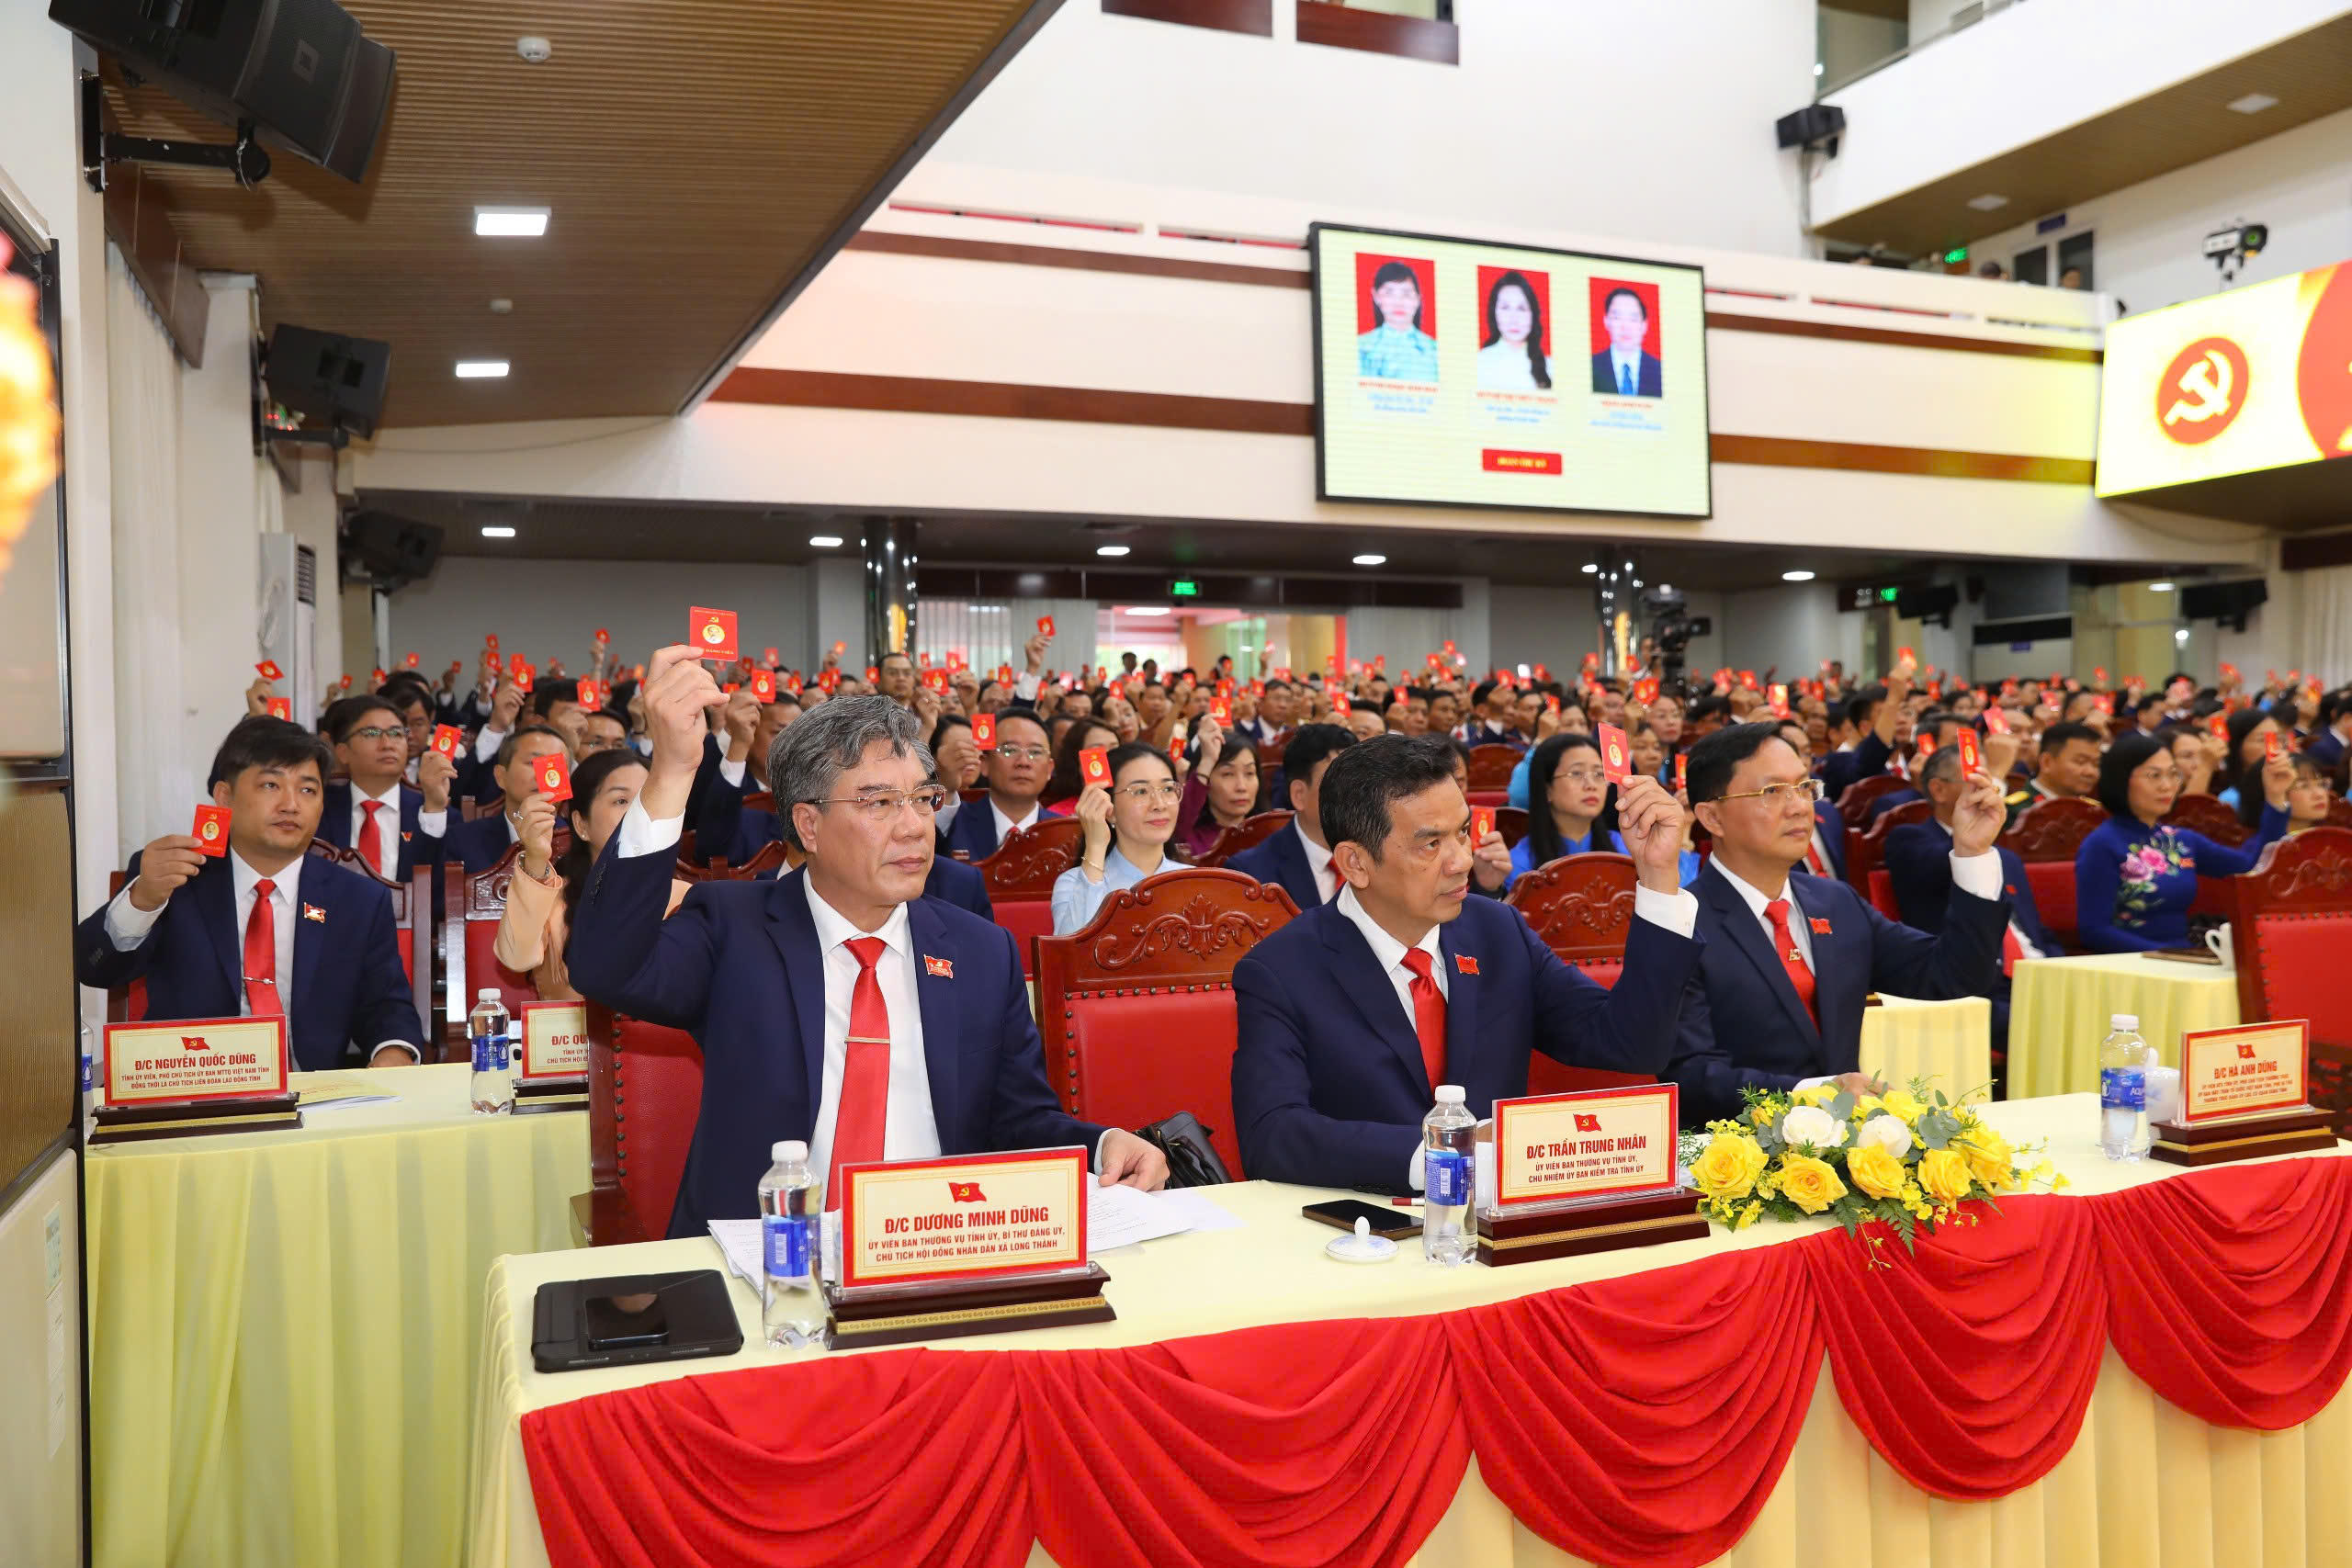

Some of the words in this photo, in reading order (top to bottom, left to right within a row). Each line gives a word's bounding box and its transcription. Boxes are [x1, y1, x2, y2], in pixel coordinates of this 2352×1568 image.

[551, 1035, 570, 1045] Đ/C
[572, 1034, 588, 1044] QU
[135, 1060, 153, 1071] Đ/C
[155, 1054, 196, 1069] NGUYỄN
[199, 1052, 226, 1067] QUỐC
[229, 1052, 256, 1066] DŨNG
[1526, 1145, 1545, 1159] Đ/C
[1548, 1138, 1577, 1157] TRẦN
[1579, 1139, 1614, 1155] TRUNG
[1617, 1134, 1646, 1151] NHÂN
[1576, 1170, 1589, 1179] BAN
[885, 1217, 910, 1234] Đ/C
[914, 1213, 963, 1231] DƯƠNG
[967, 1210, 1005, 1227] MINH
[1011, 1205, 1048, 1224] DŨNG
[902, 1238, 918, 1247] BAN
[1011, 1241, 1030, 1251] LONG
